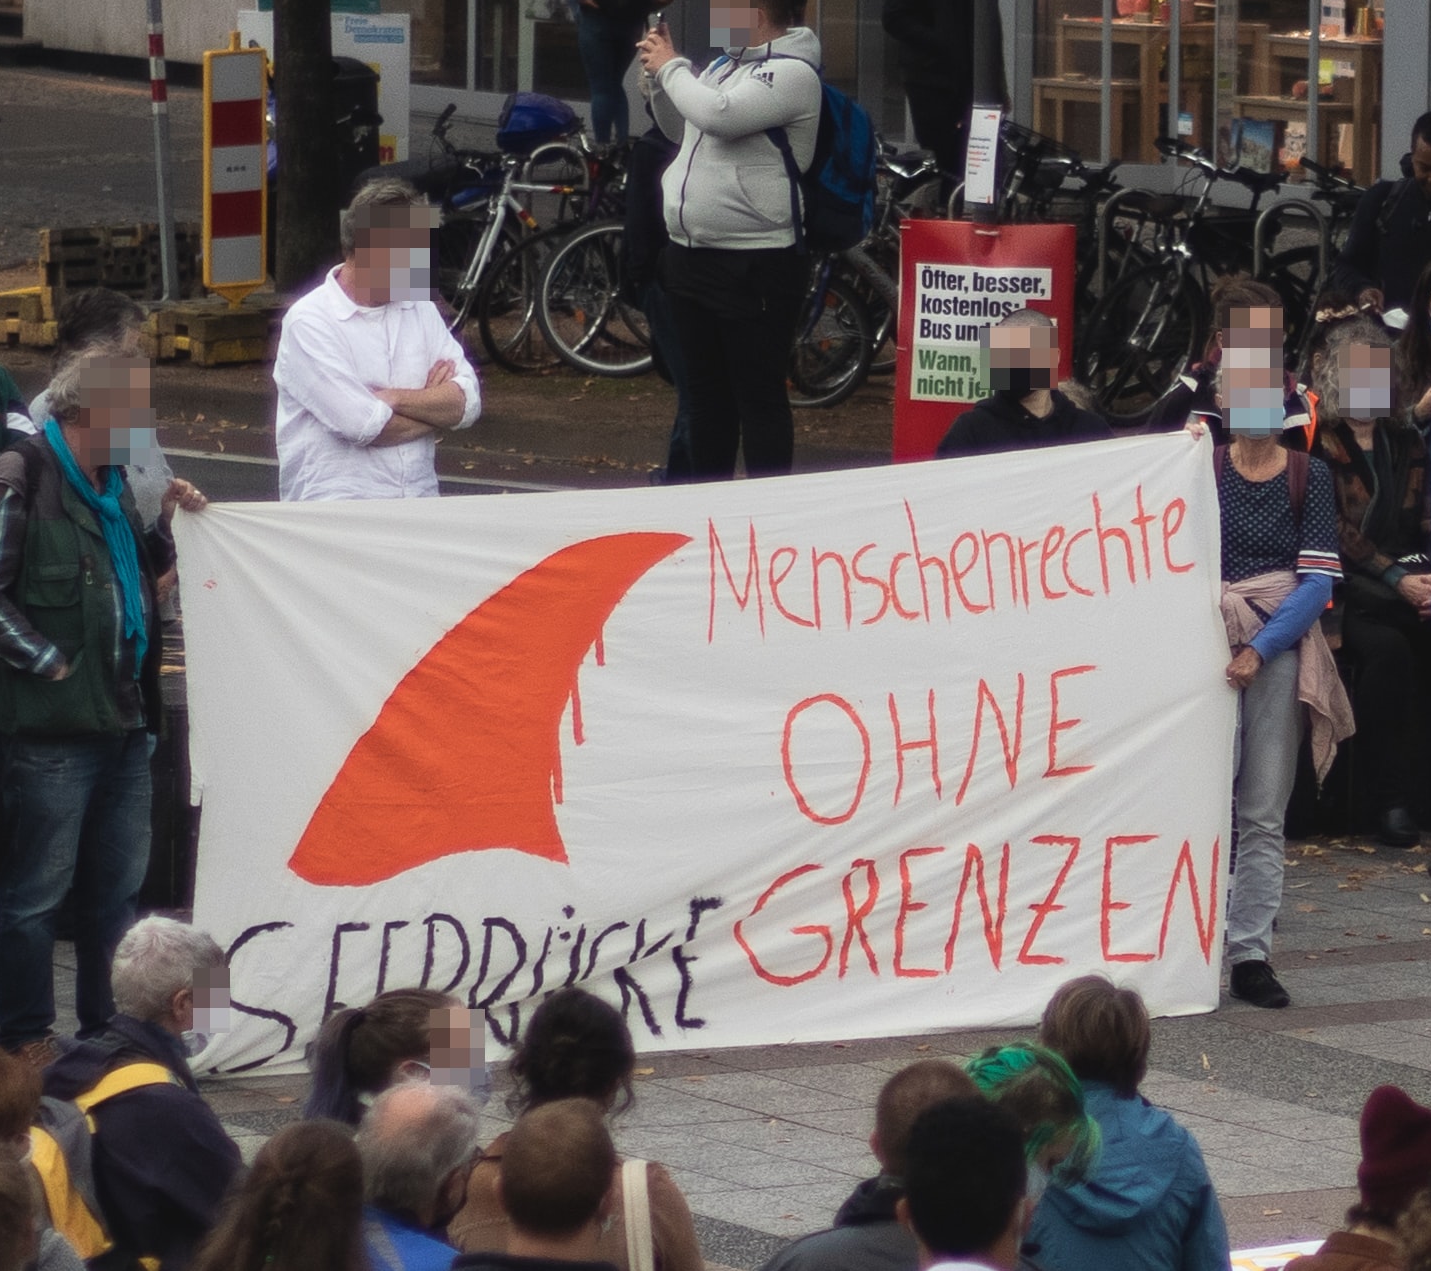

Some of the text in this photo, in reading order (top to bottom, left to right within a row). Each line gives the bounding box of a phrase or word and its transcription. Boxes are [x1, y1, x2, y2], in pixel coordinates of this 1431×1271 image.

[922, 265, 1046, 296] Öfter, besser,
[920, 318, 952, 339] Bus
[919, 349, 977, 375] Wann,
[917, 377, 964, 397] nicht
[706, 483, 1198, 643] Menschenrechte
[780, 663, 1101, 826] OHNE
[737, 833, 1221, 987] GRENZEN
